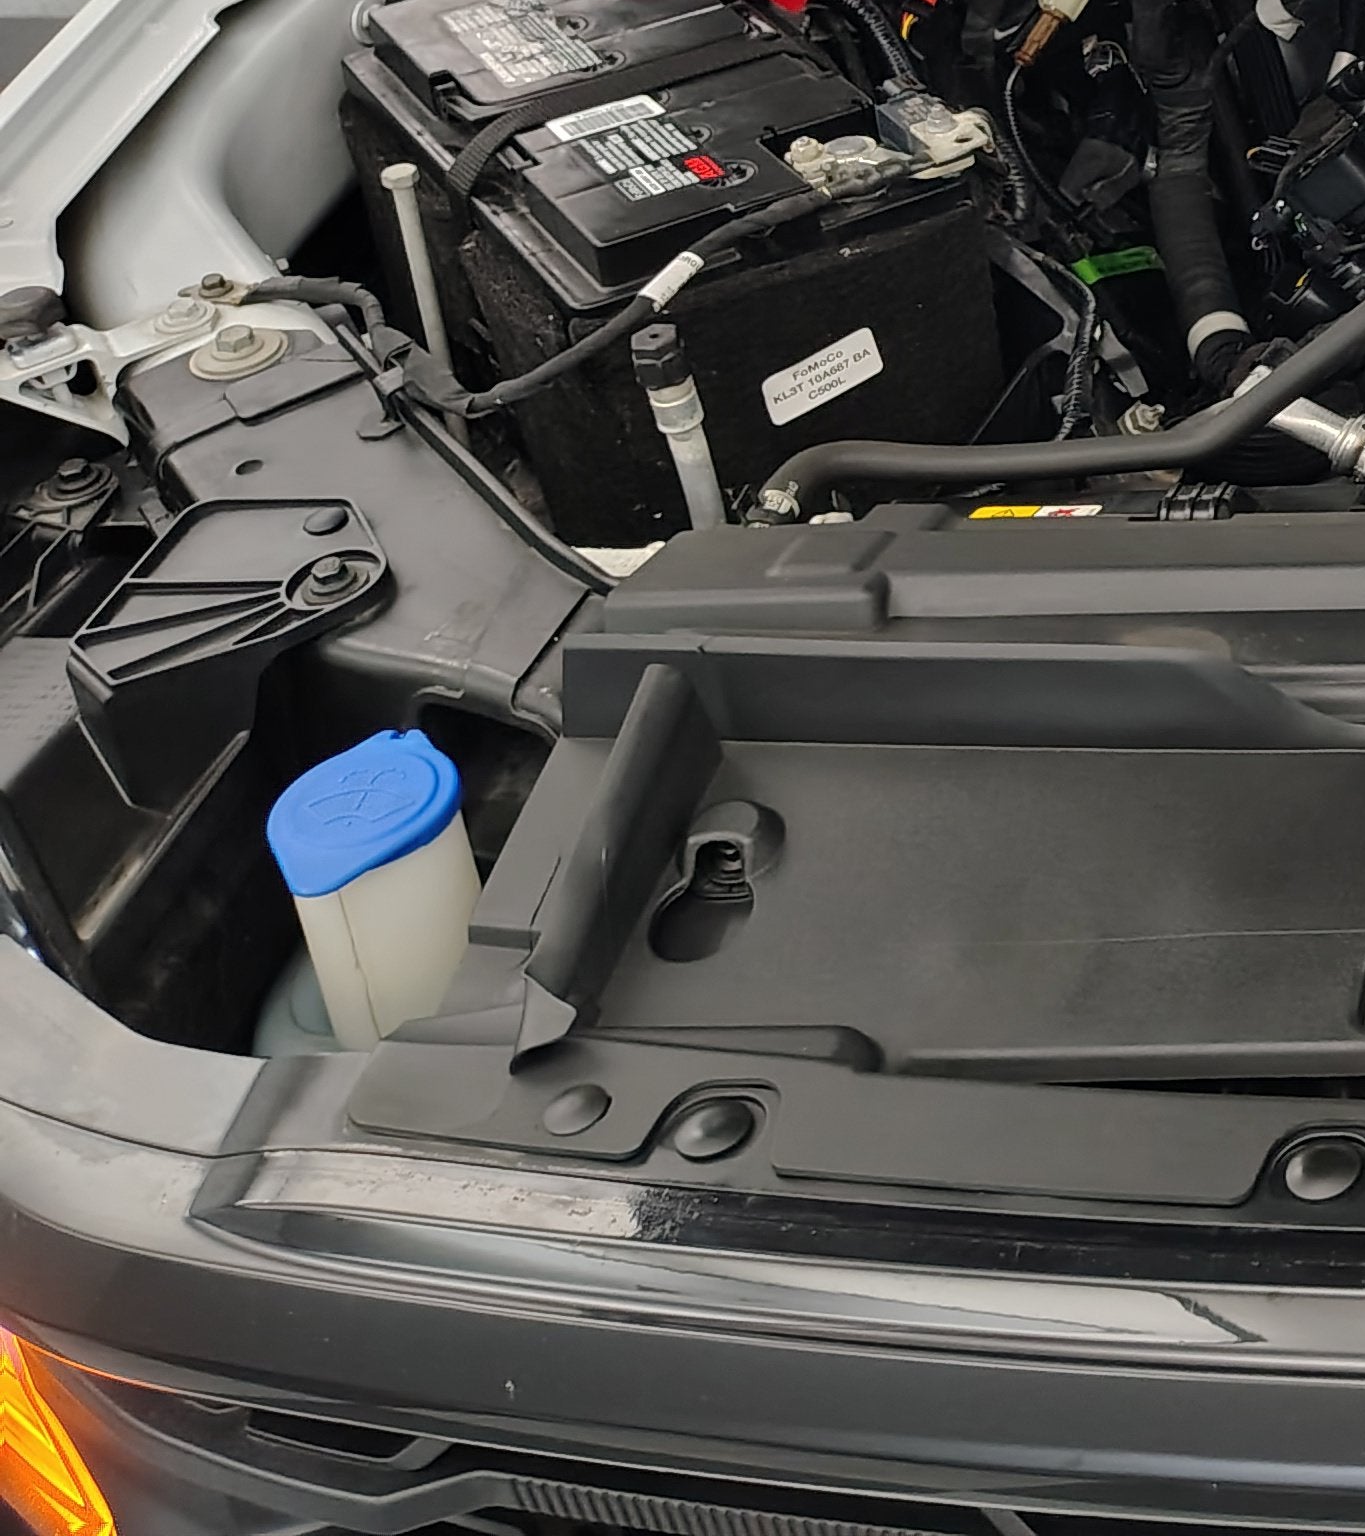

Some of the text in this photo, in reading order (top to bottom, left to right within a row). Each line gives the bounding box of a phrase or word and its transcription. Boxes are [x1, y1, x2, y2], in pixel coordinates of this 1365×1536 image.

[772, 348, 871, 405] KL3T 10A687 BA
[791, 350, 844, 382] FoMoCo
[808, 375, 847, 401] C500L
